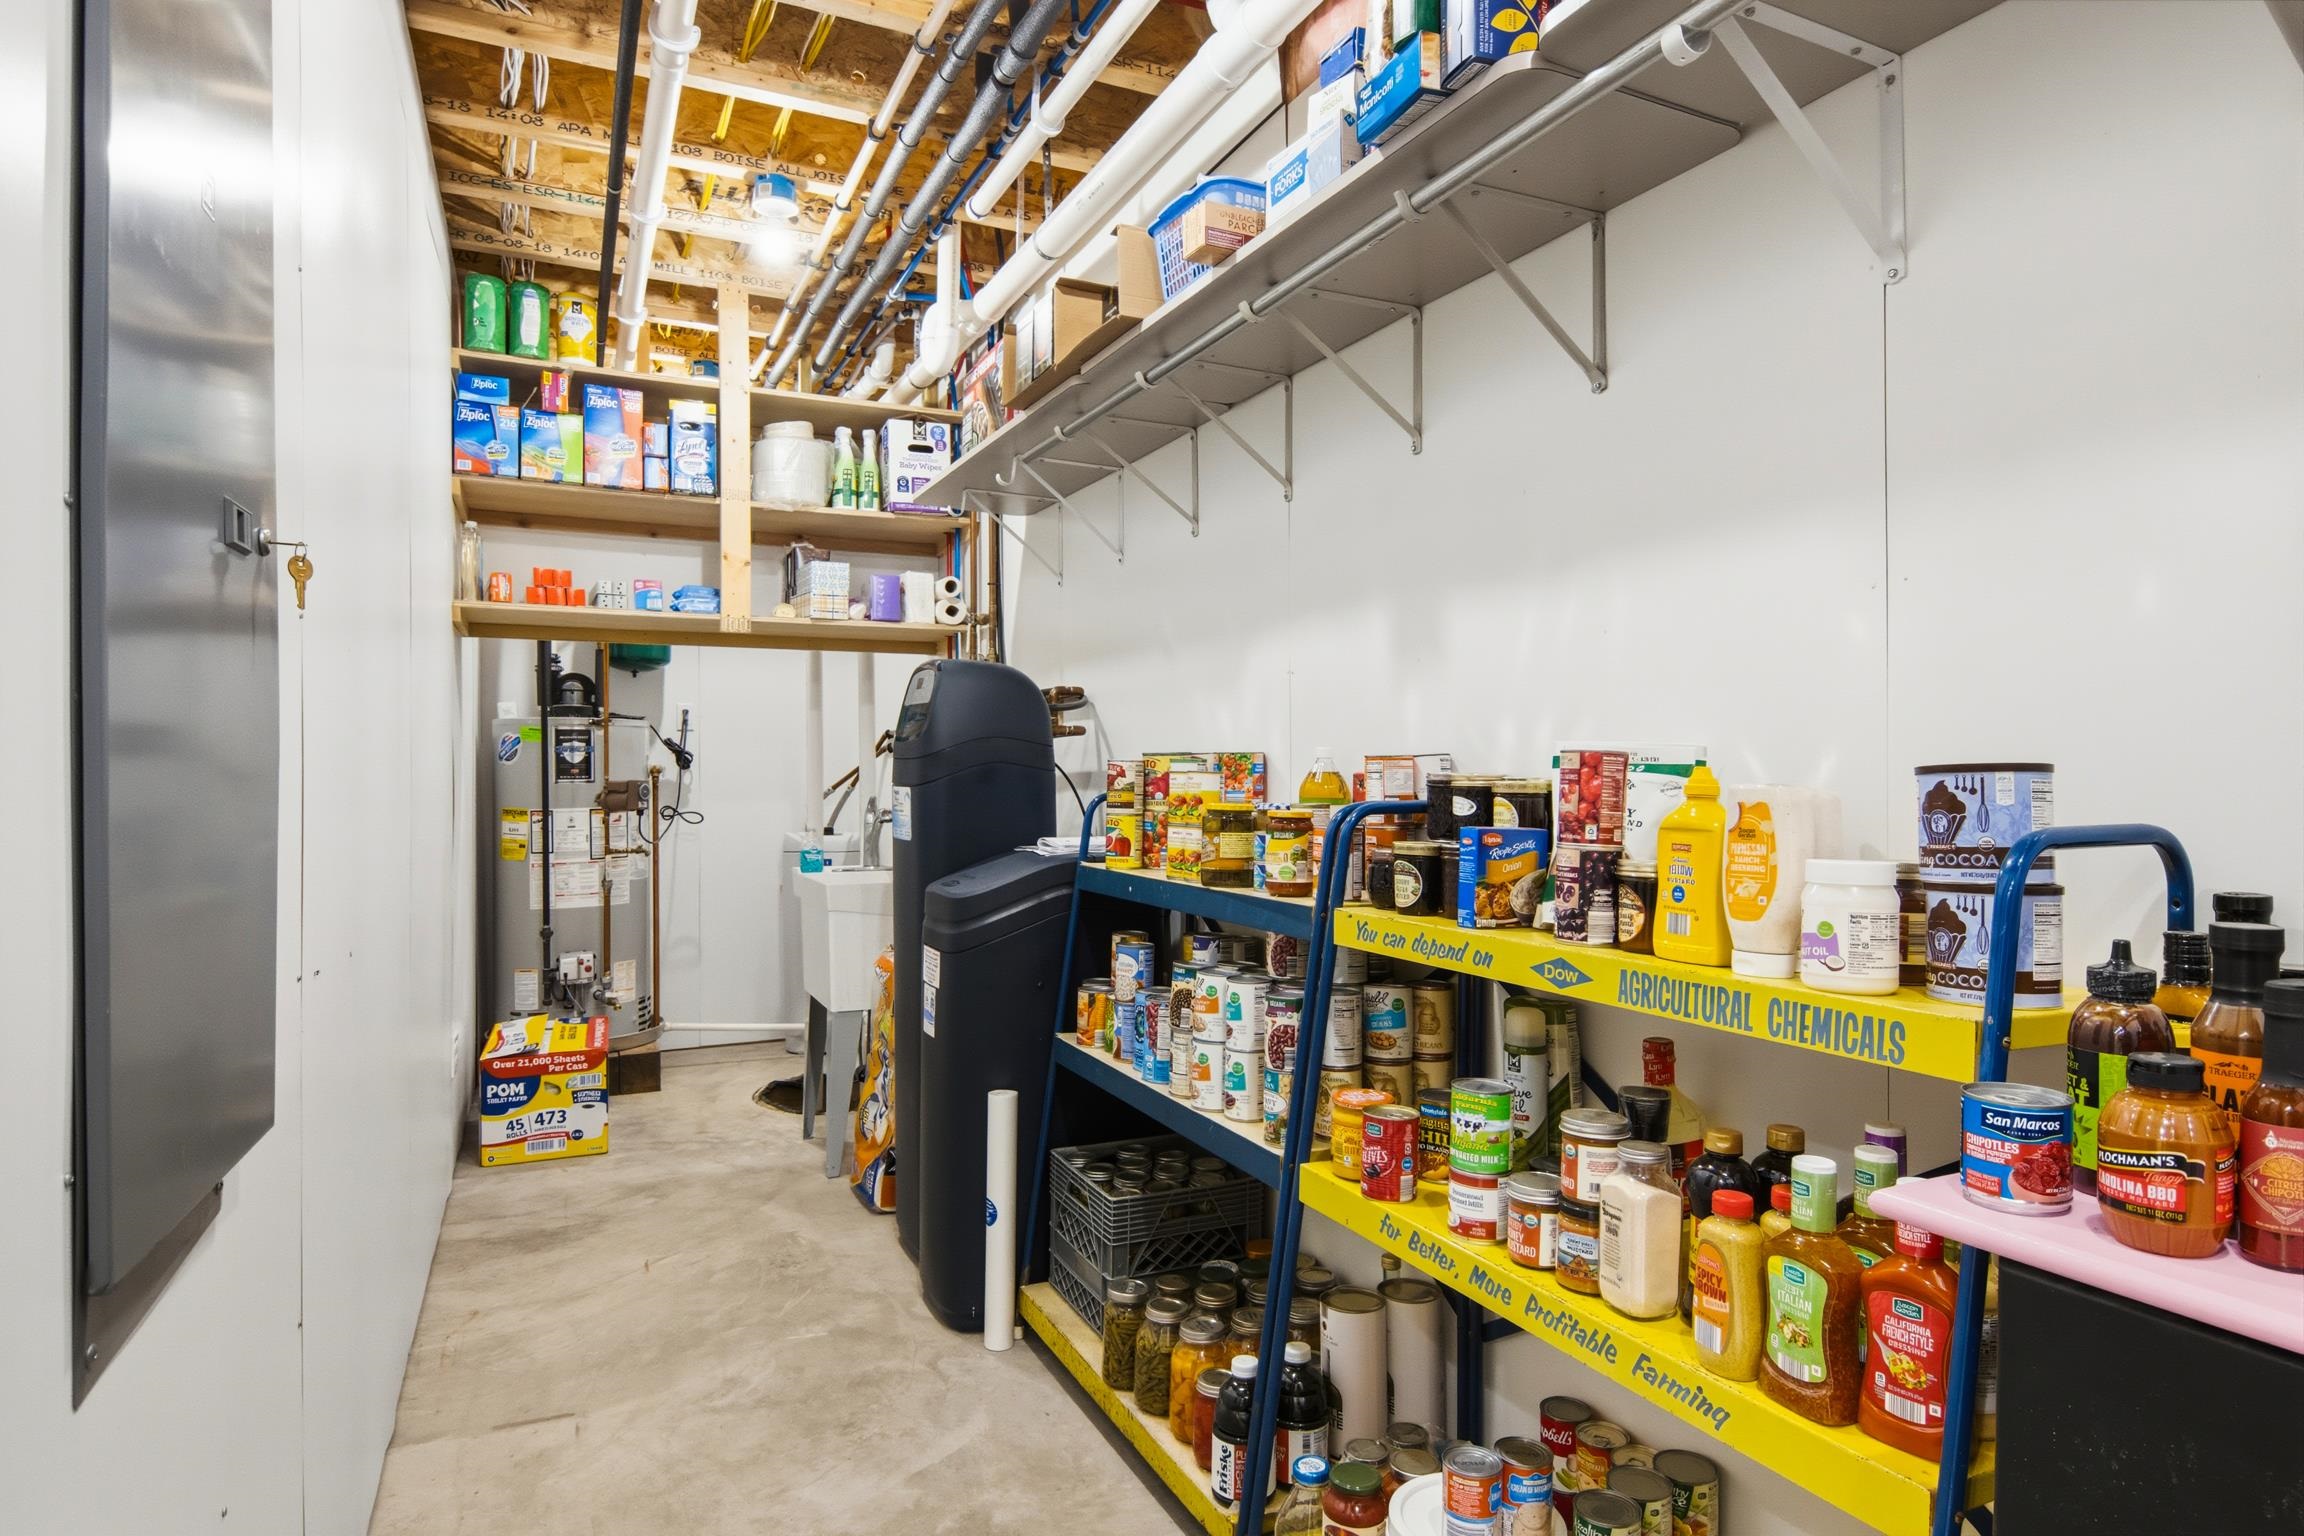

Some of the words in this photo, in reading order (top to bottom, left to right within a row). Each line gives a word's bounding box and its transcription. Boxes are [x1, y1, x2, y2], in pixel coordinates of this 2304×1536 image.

[557, 121, 592, 136] APA
[714, 150, 767, 170] BOISE
[1274, 163, 1303, 196] FORKS
[472, 378, 498, 390] Ziploc
[589, 395, 618, 408] Ziploc
[460, 408, 490, 421] Ziploc
[525, 416, 556, 429] Ziploc
[899, 461, 917, 470] Baby
[1502, 861, 1522, 873] Onion
[1935, 853, 1999, 867] COCOA
[1812, 946, 1829, 956] OIL
[1938, 971, 1987, 988] COCO
[1356, 919, 1379, 943] You
[1382, 931, 1406, 950] can
[1411, 932, 1470, 963] depend
[1472, 949, 1494, 969] on
[1617, 968, 1753, 1032] AGRICULTURAL
[1767, 996, 1906, 1065] CHEMICALS
[492, 1061, 515, 1070] Over
[518, 1057, 552, 1067] 21,000
[553, 1054, 586, 1064] Sheets
[549, 1064, 564, 1072] Per
[566, 1062, 588, 1071] Case
[2209, 1066, 2256, 1080] TRAEGER
[486, 1083, 525, 1098] POM
[506, 1118, 524, 1132] 45
[534, 1110, 567, 1126] 473
[1985, 1112, 2010, 1128] San
[2013, 1117, 2060, 1131] Marcos
[506, 1130, 528, 1139] ROLLS
[1966, 1132, 2019, 1154] CHIPOTLES
[2143, 1171, 2185, 1184] Tangy
[2147, 1185, 2177, 1202] BBQ
[1777, 1290, 1812, 1314] ITALIAN
[1379, 1213, 1402, 1240] for
[1408, 1230, 1459, 1279] Better,
[1468, 1264, 1512, 1307] More
[1524, 1292, 1618, 1365] Profitable
[1631, 1352, 1732, 1432] Farming
[1885, 1315, 1931, 1338] CALIFORNIA
[1882, 1323, 1909, 1343] FRENCH
[1909, 1331, 1934, 1352] STYLE
[1888, 1338, 1927, 1358] DRESSING
